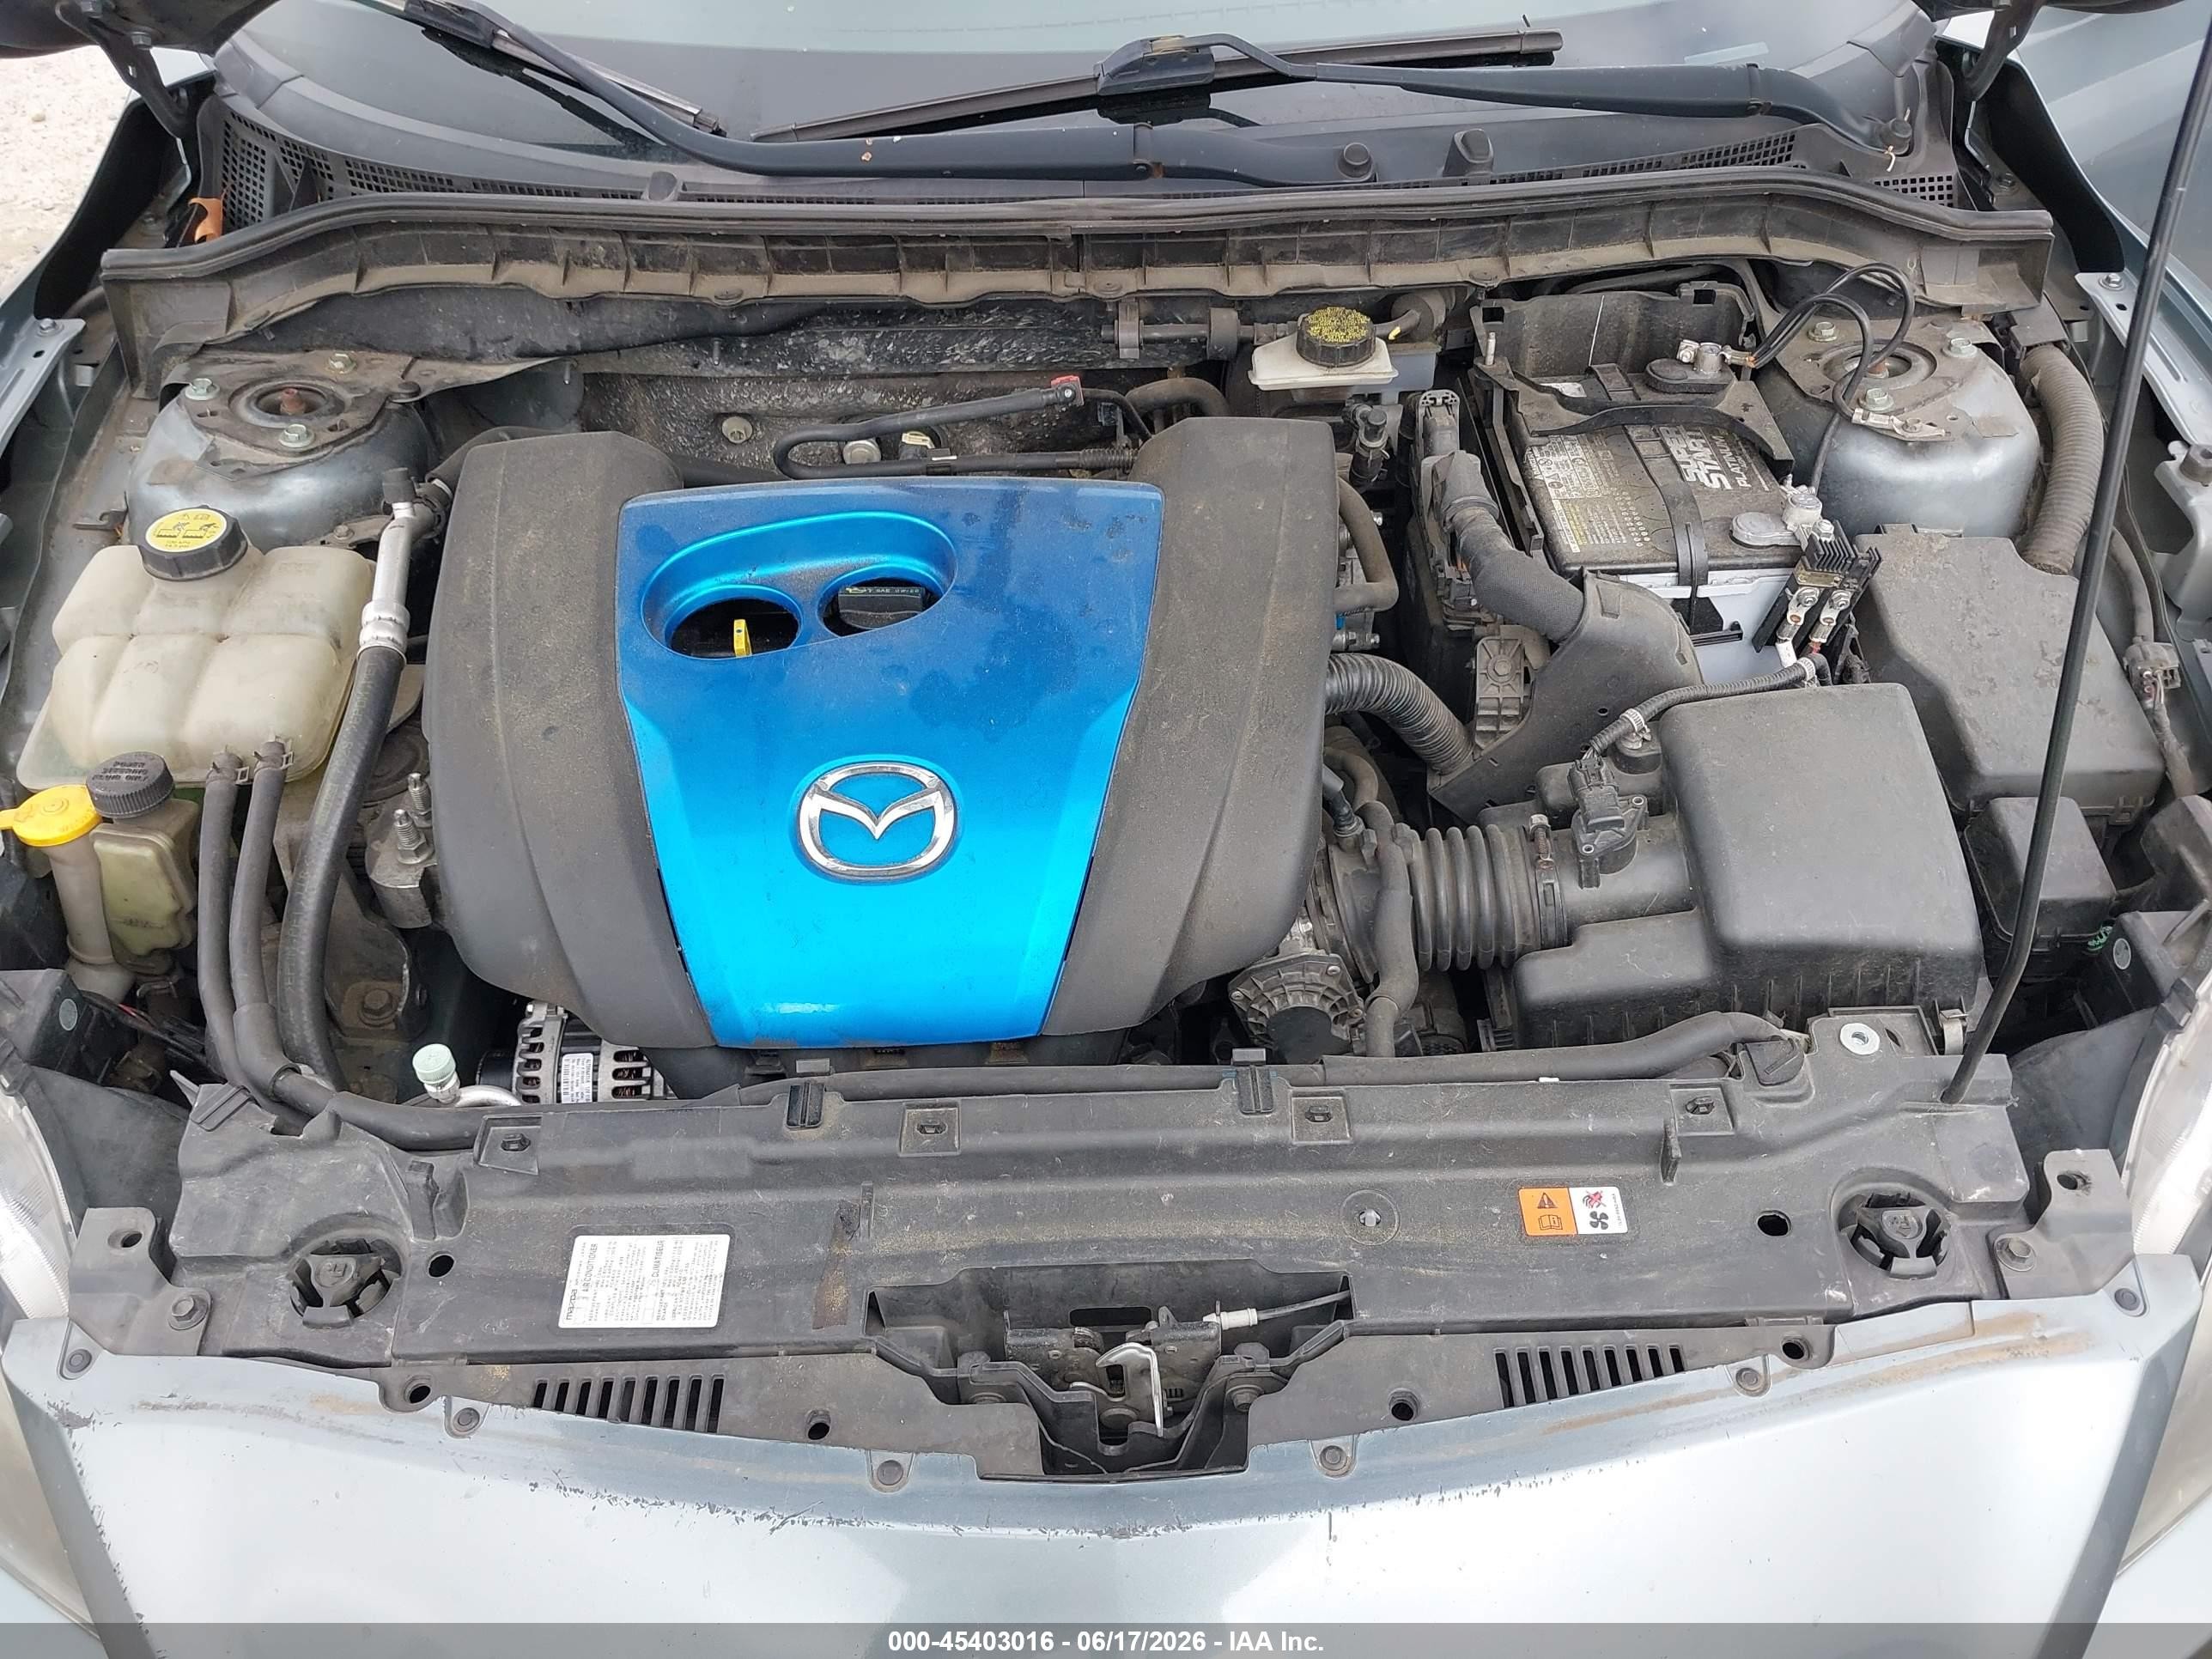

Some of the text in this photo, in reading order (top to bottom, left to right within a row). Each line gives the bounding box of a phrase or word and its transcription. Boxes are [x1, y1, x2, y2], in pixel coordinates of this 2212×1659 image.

[1659, 425, 1698, 482] SUPER
[1686, 430, 1733, 489] START
[1712, 434, 1752, 488] PLATINUM
[584, 1243, 599, 1282] CONDITIONER
[652, 1239, 665, 1278] CLIMATISEUR
[566, 1288, 578, 1321] mazda
